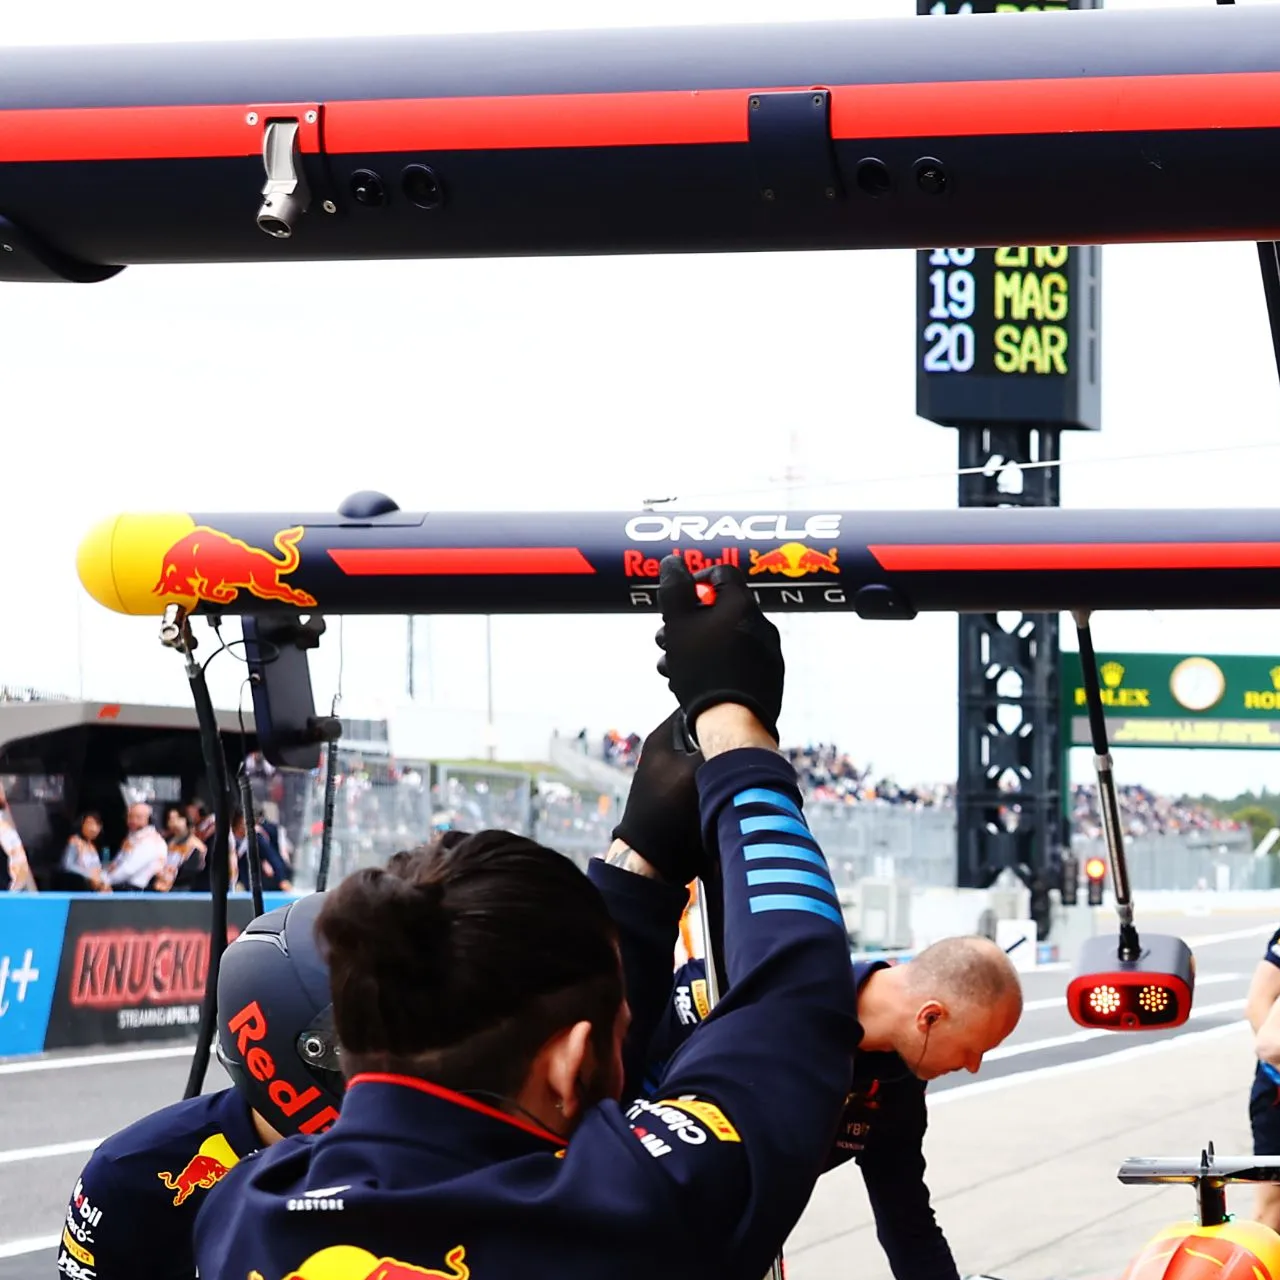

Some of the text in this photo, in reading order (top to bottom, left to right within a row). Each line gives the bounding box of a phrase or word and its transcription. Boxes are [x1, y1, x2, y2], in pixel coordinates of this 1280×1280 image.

[928, 269, 1068, 321] 19 MAG
[924, 323, 1068, 374] 20 SAR
[624, 514, 843, 542] ORACLE
[623, 547, 680, 577] Re
[630, 588, 847, 606] RING
[1074, 687, 1150, 707] RLEX
[74, 937, 209, 1001] KNUCKL
[228, 1000, 322, 1118] Red
[286, 1198, 345, 1212] CASTORE
